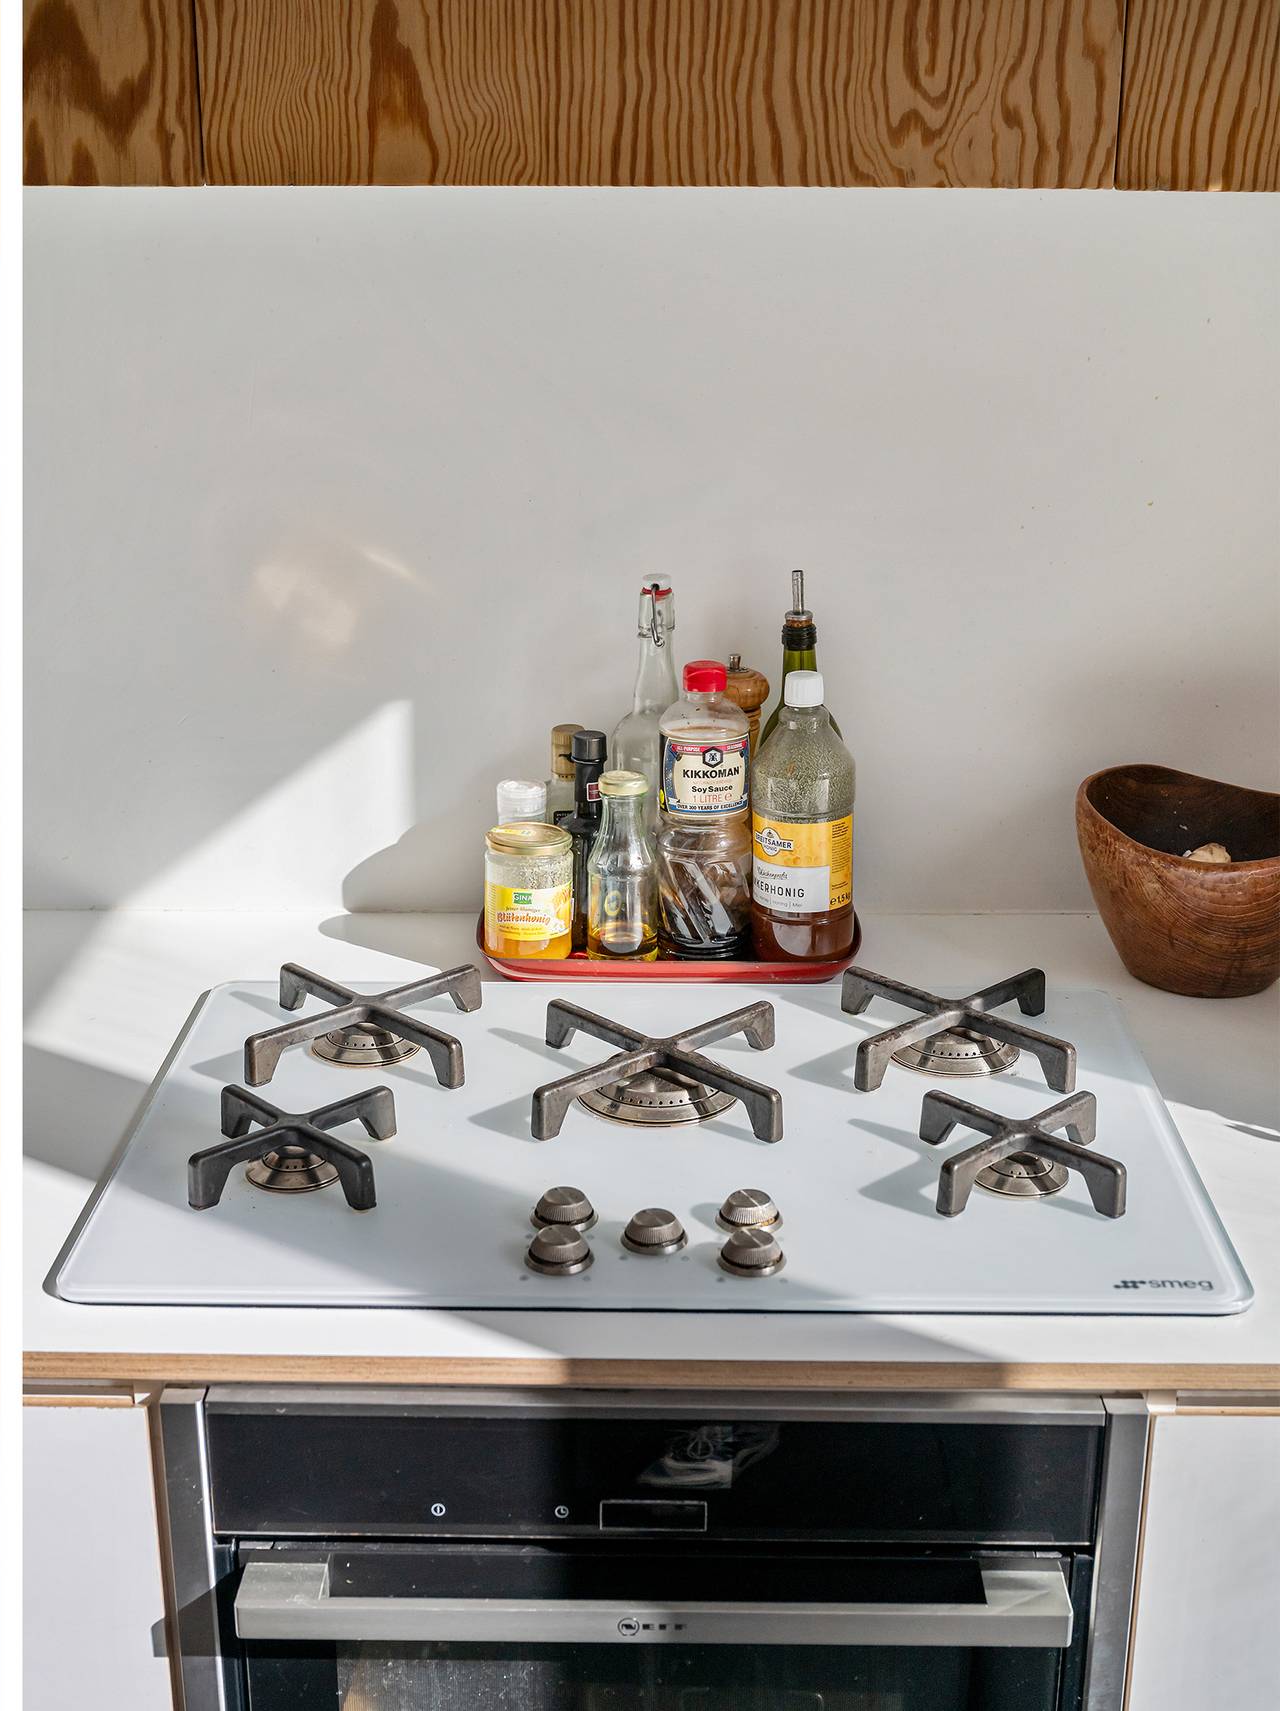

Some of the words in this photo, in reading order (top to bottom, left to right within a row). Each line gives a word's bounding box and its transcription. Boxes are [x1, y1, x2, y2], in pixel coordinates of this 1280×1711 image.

[682, 766, 740, 779] KIKKOMAN
[691, 785, 707, 794] Soy
[708, 785, 733, 793] Sauce
[700, 794, 722, 803] LITRE
[753, 878, 805, 898] KERHONIG
[1149, 1280, 1214, 1291] smeg
